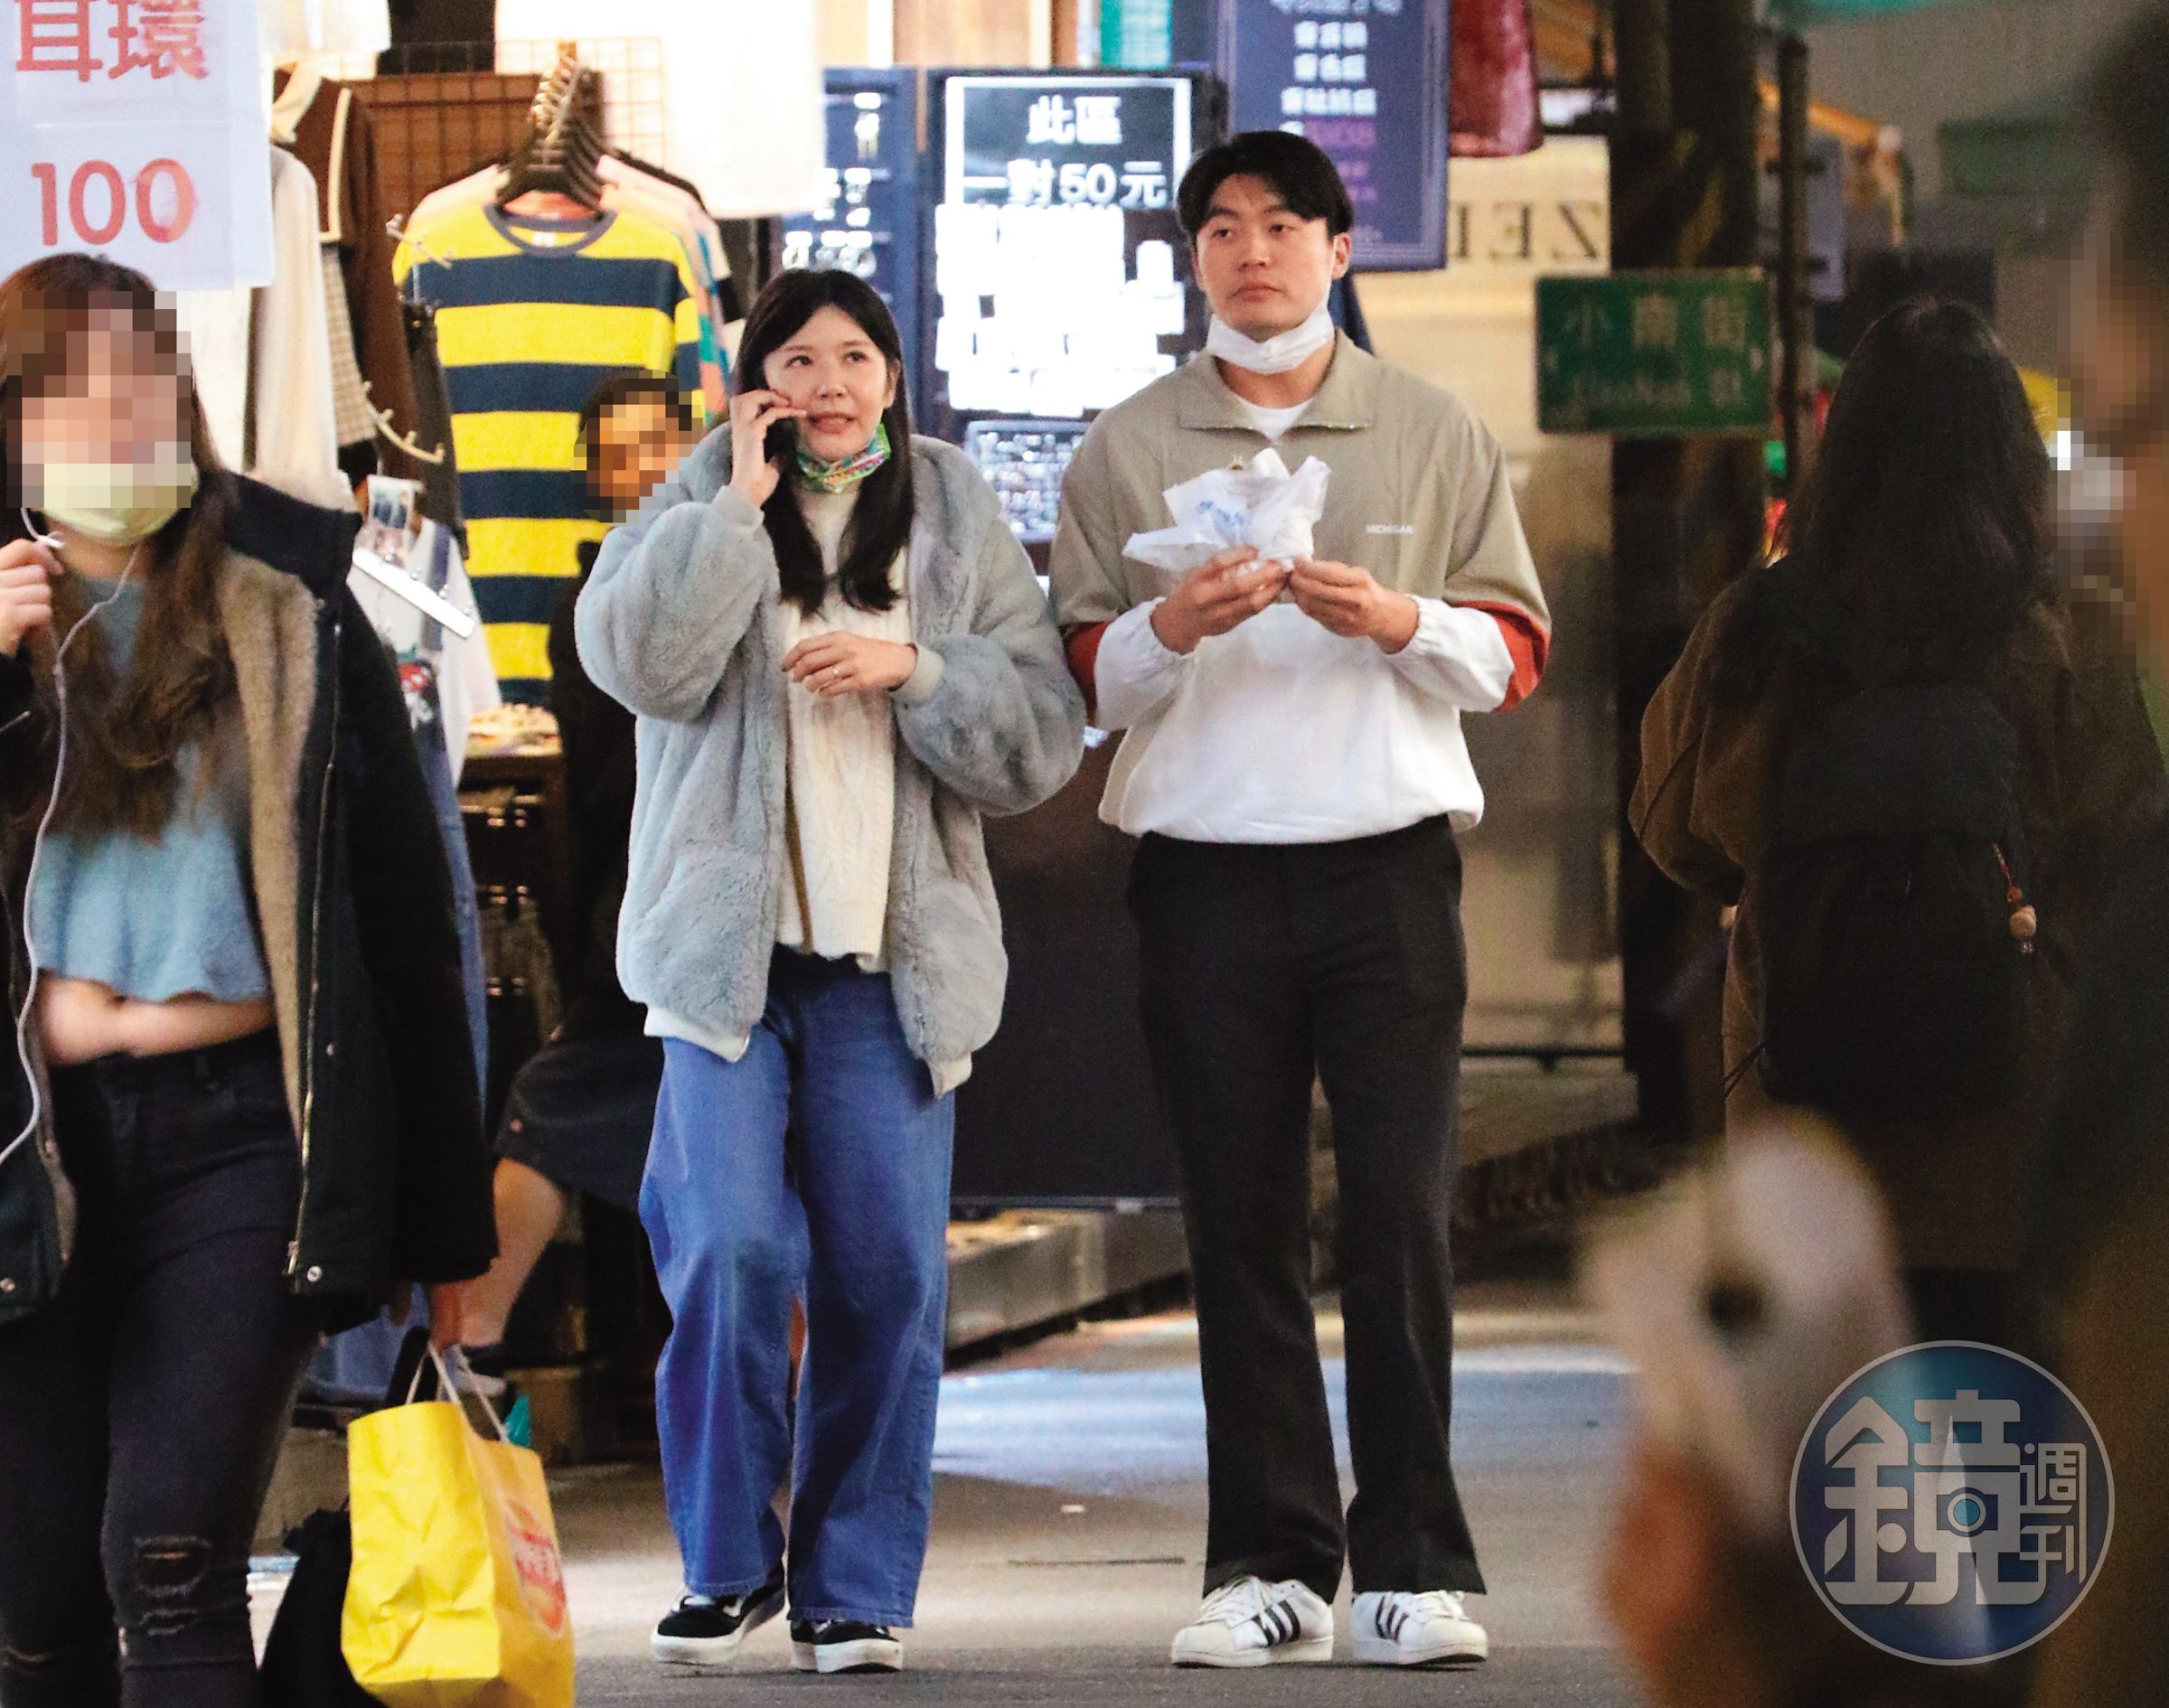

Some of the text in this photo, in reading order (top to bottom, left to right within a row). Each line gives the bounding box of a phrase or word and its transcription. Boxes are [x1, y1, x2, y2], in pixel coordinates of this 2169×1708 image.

[15, 0, 210, 82] 耳環
[1028, 95, 1123, 145] 此區
[31, 157, 196, 246] 100
